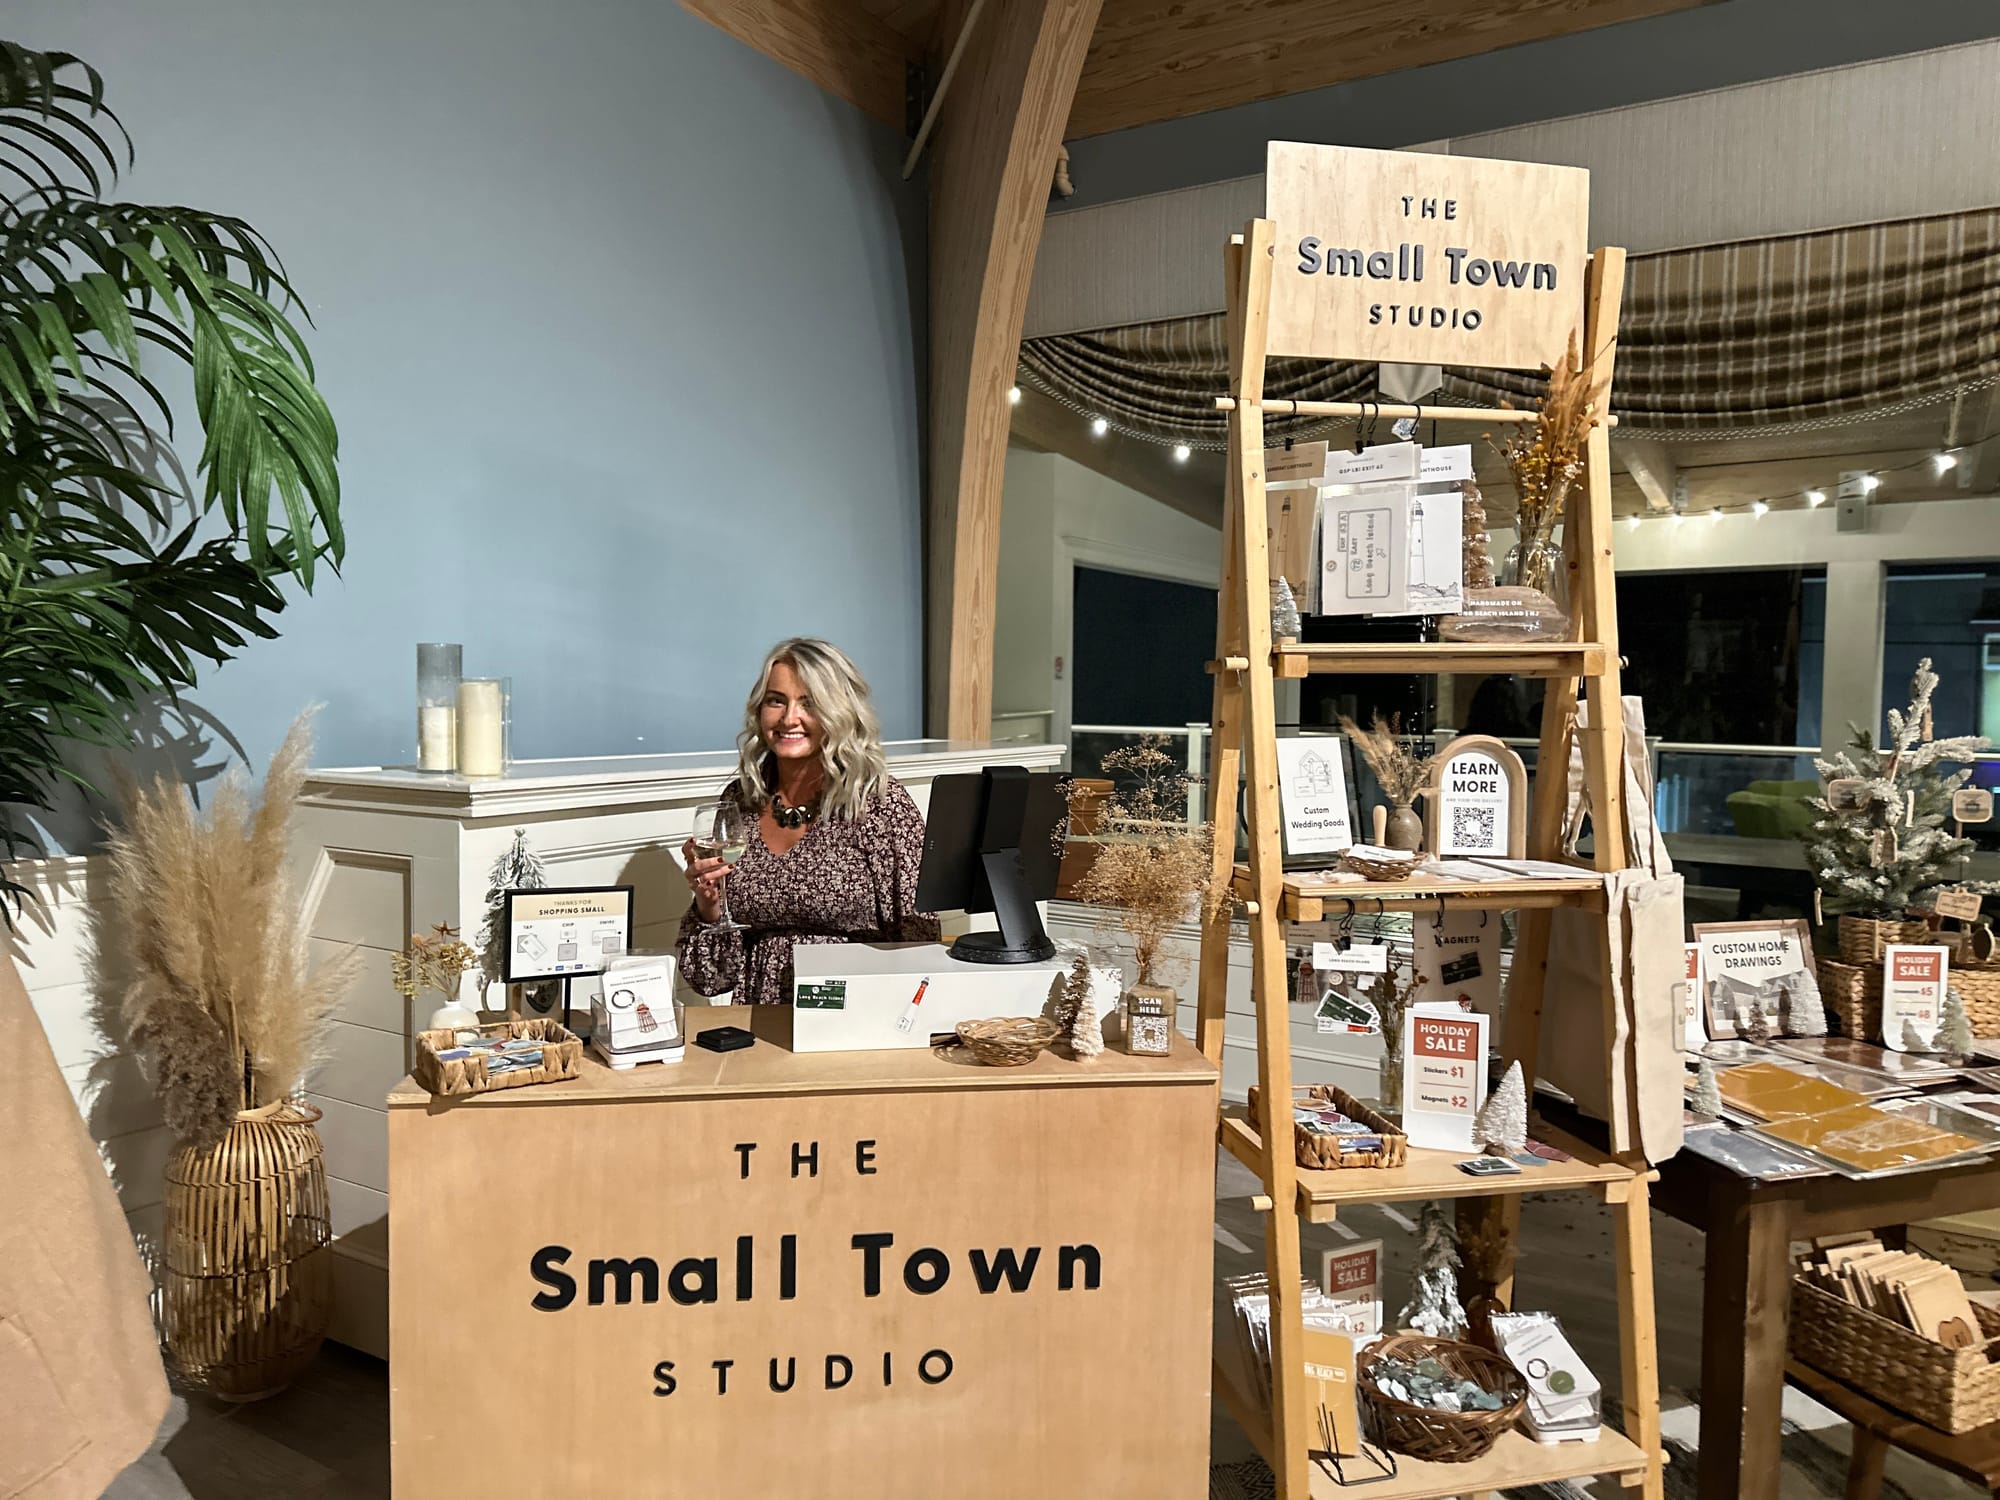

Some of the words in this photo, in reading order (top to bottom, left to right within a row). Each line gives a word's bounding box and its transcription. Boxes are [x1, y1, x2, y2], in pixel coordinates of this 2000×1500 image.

[1402, 195, 1457, 220] THE
[1298, 236, 1424, 281] Small
[1445, 247, 1558, 290] Town
[1369, 303, 1482, 331] STUDIO
[1366, 513, 1375, 541] Island
[1365, 572, 1375, 594] Long
[1452, 762, 1499, 775] LEARN
[1453, 780, 1497, 793] MORE
[1291, 820, 1322, 829] Wedding
[1323, 819, 1345, 827] Goods
[539, 907, 579, 915] SHOPPING
[1712, 942, 1757, 954] CUSTOM
[1759, 940, 1789, 952] HOME
[1725, 956, 1782, 968] DRAWINGS
[1896, 956, 1935, 964] HOLIDAY
[1900, 966, 1931, 976] SALE
[1921, 987, 1933, 996] $5
[1138, 997, 1162, 1005] SCAN
[1139, 1006, 1161, 1014] HERE
[1420, 1023, 1471, 1037] HOLIDAY
[1425, 1036, 1466, 1052] SALE
[1424, 1066, 1448, 1074] Stickers
[1451, 1066, 1464, 1078] $1
[1421, 1095, 1448, 1103] Magnets
[1451, 1096, 1467, 1108] $2
[734, 1139, 878, 1179] THE
[1334, 1256, 1370, 1271] HOLIDAY
[530, 1234, 797, 1311] Small
[851, 1232, 1102, 1297] Town
[1337, 1268, 1367, 1285] SALE
[1359, 1293, 1370, 1304] $3
[1353, 1321, 1365, 1334] $2
[653, 1349, 954, 1396] STUDIO
